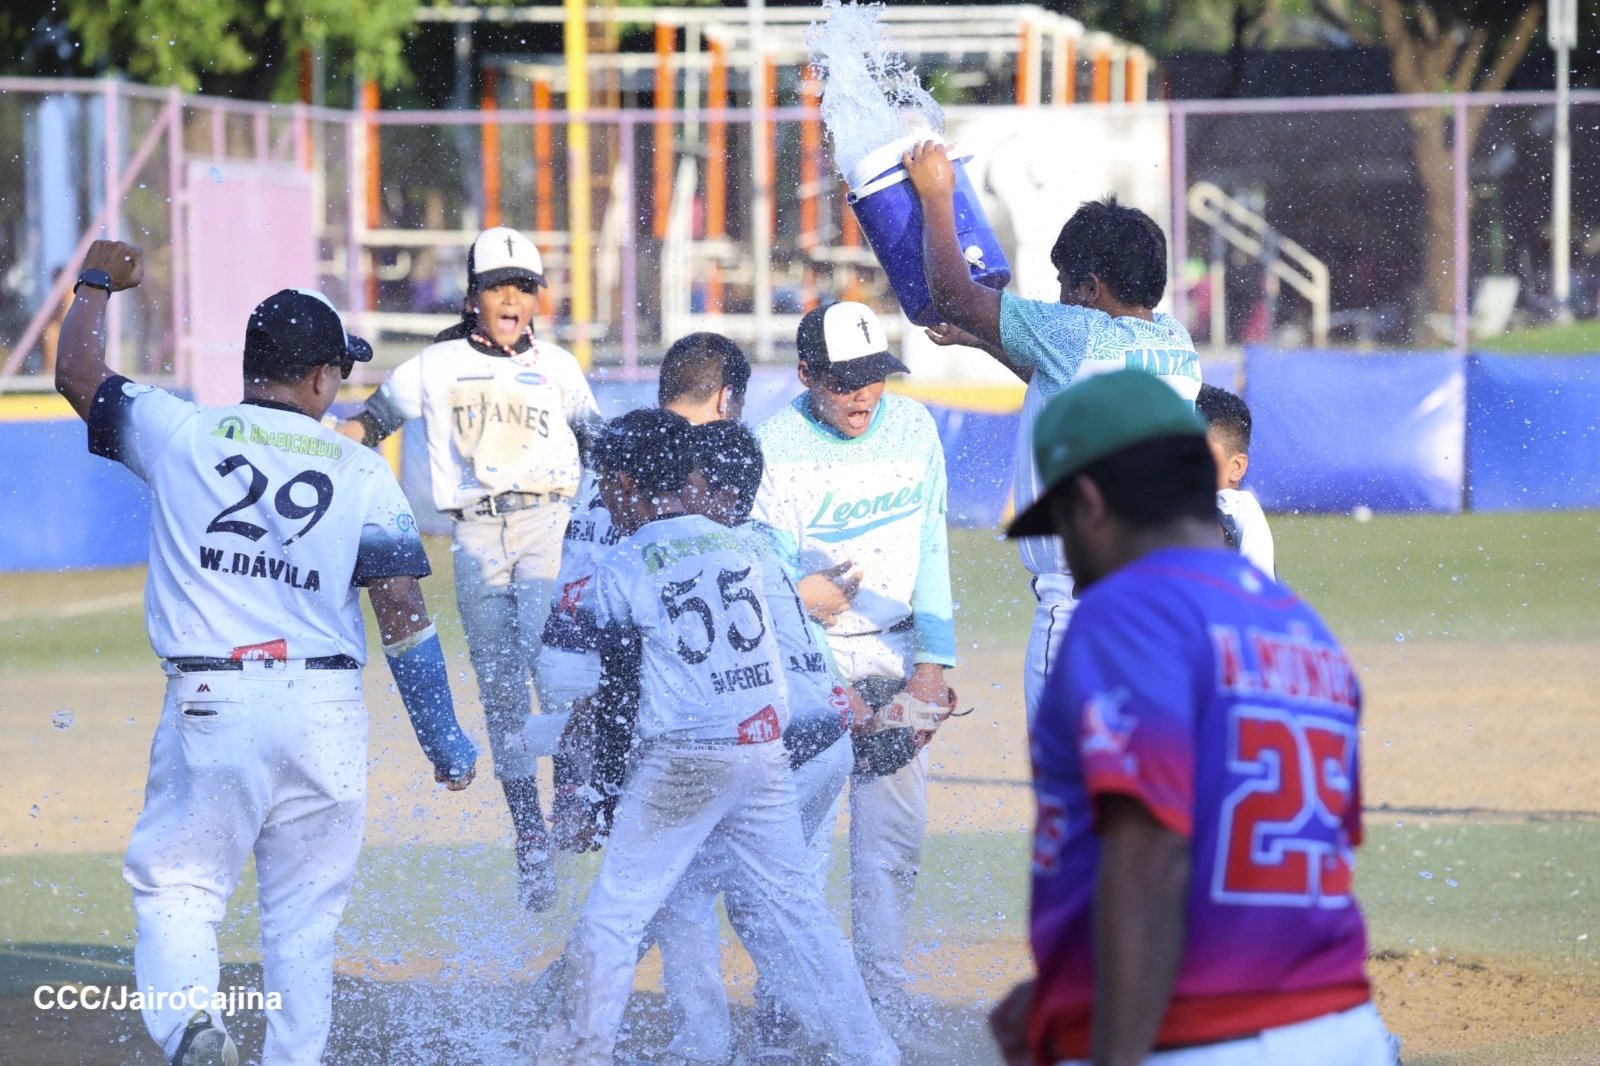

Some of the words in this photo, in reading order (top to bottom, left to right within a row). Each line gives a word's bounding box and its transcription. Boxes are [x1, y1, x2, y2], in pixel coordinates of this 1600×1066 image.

[206, 453, 334, 547] 29
[806, 480, 924, 529] Leones
[199, 545, 321, 593] W.DÁVILA
[661, 566, 767, 665] 55
